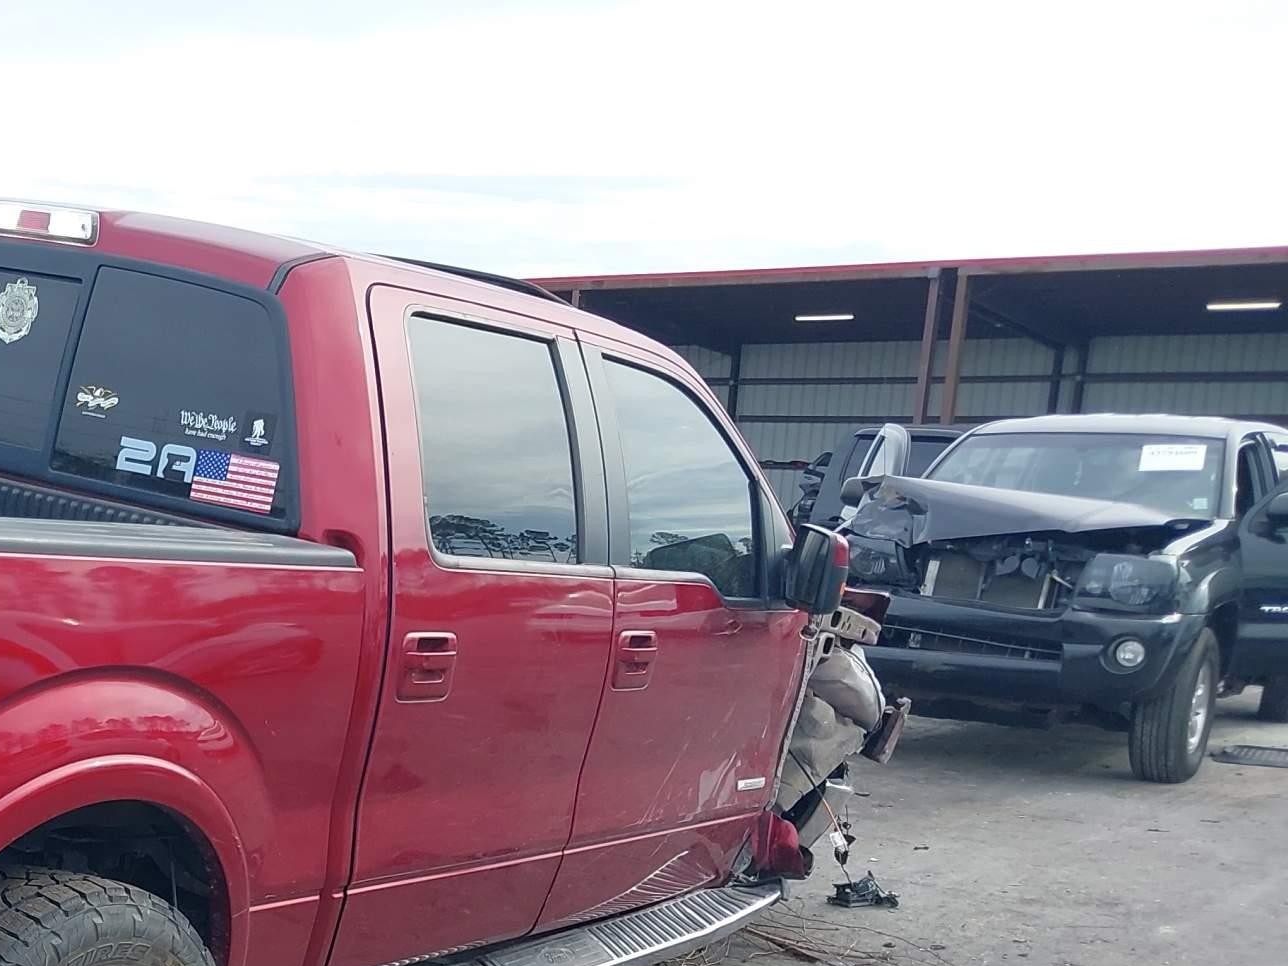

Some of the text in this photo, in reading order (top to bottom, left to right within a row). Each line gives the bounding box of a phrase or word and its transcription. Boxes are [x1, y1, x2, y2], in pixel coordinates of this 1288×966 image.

[180, 410, 195, 427] We
[208, 413, 237, 434] People
[115, 436, 198, 484] 2A
